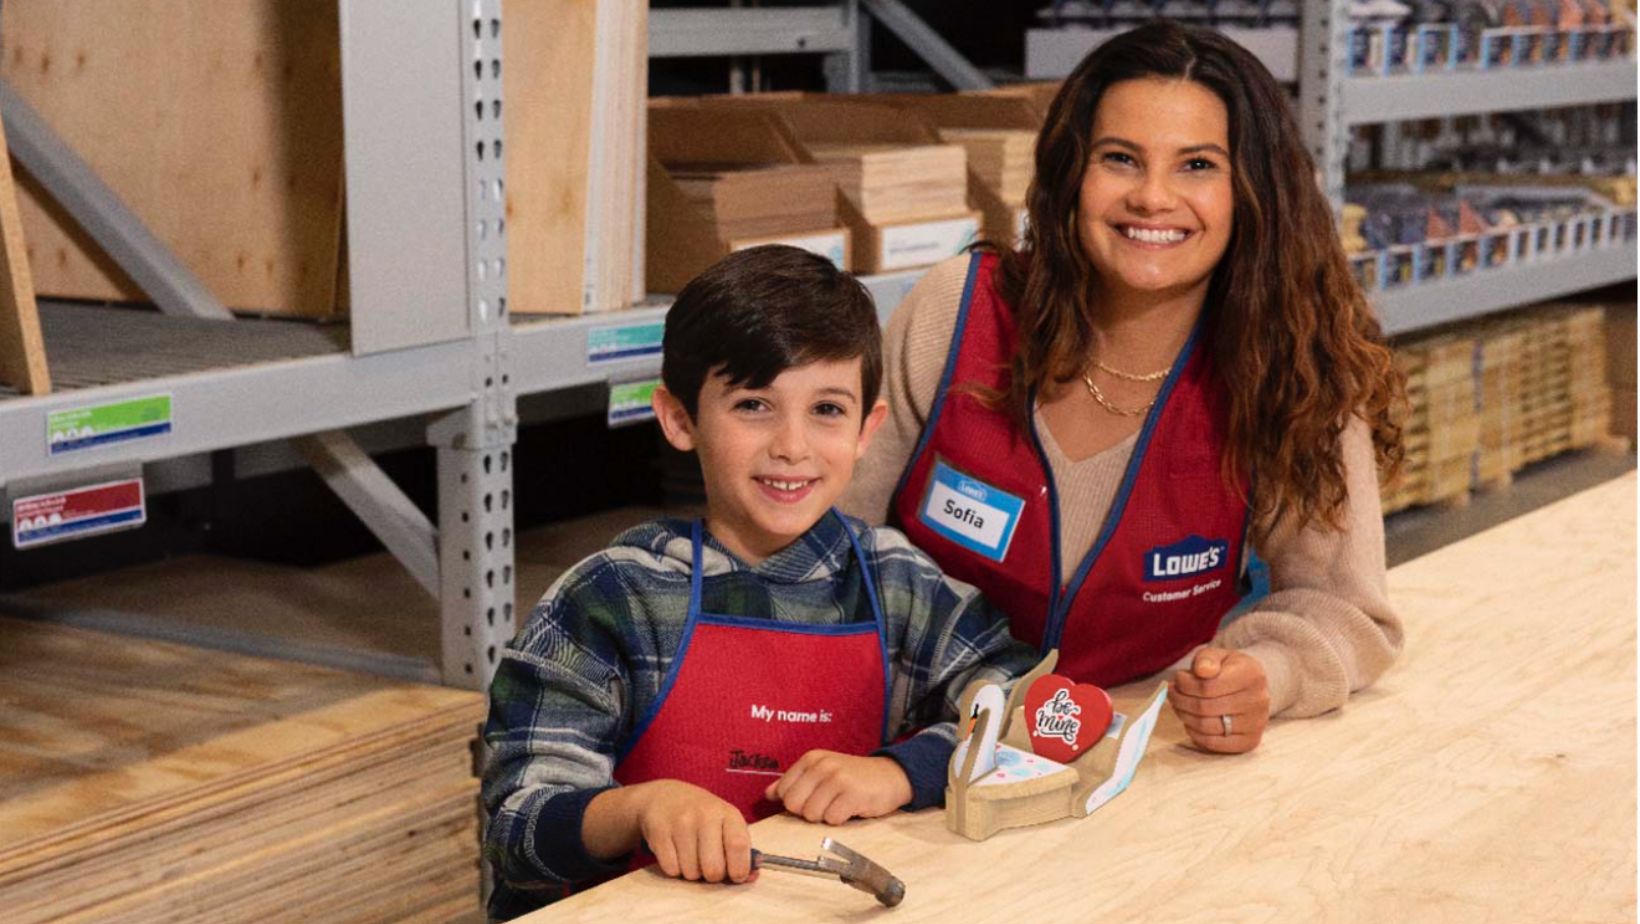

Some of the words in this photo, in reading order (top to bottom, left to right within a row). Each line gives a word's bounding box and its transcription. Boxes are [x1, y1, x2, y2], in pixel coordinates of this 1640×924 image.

[943, 498, 985, 529] Sofia
[1153, 546, 1221, 576] LOWE'S
[1142, 588, 1192, 603] Customer
[1192, 579, 1222, 597] Service
[751, 703, 775, 723] My
[777, 709, 817, 723] name
[818, 709, 833, 722] is:
[1045, 690, 1079, 716] be
[1037, 709, 1079, 742] mine
